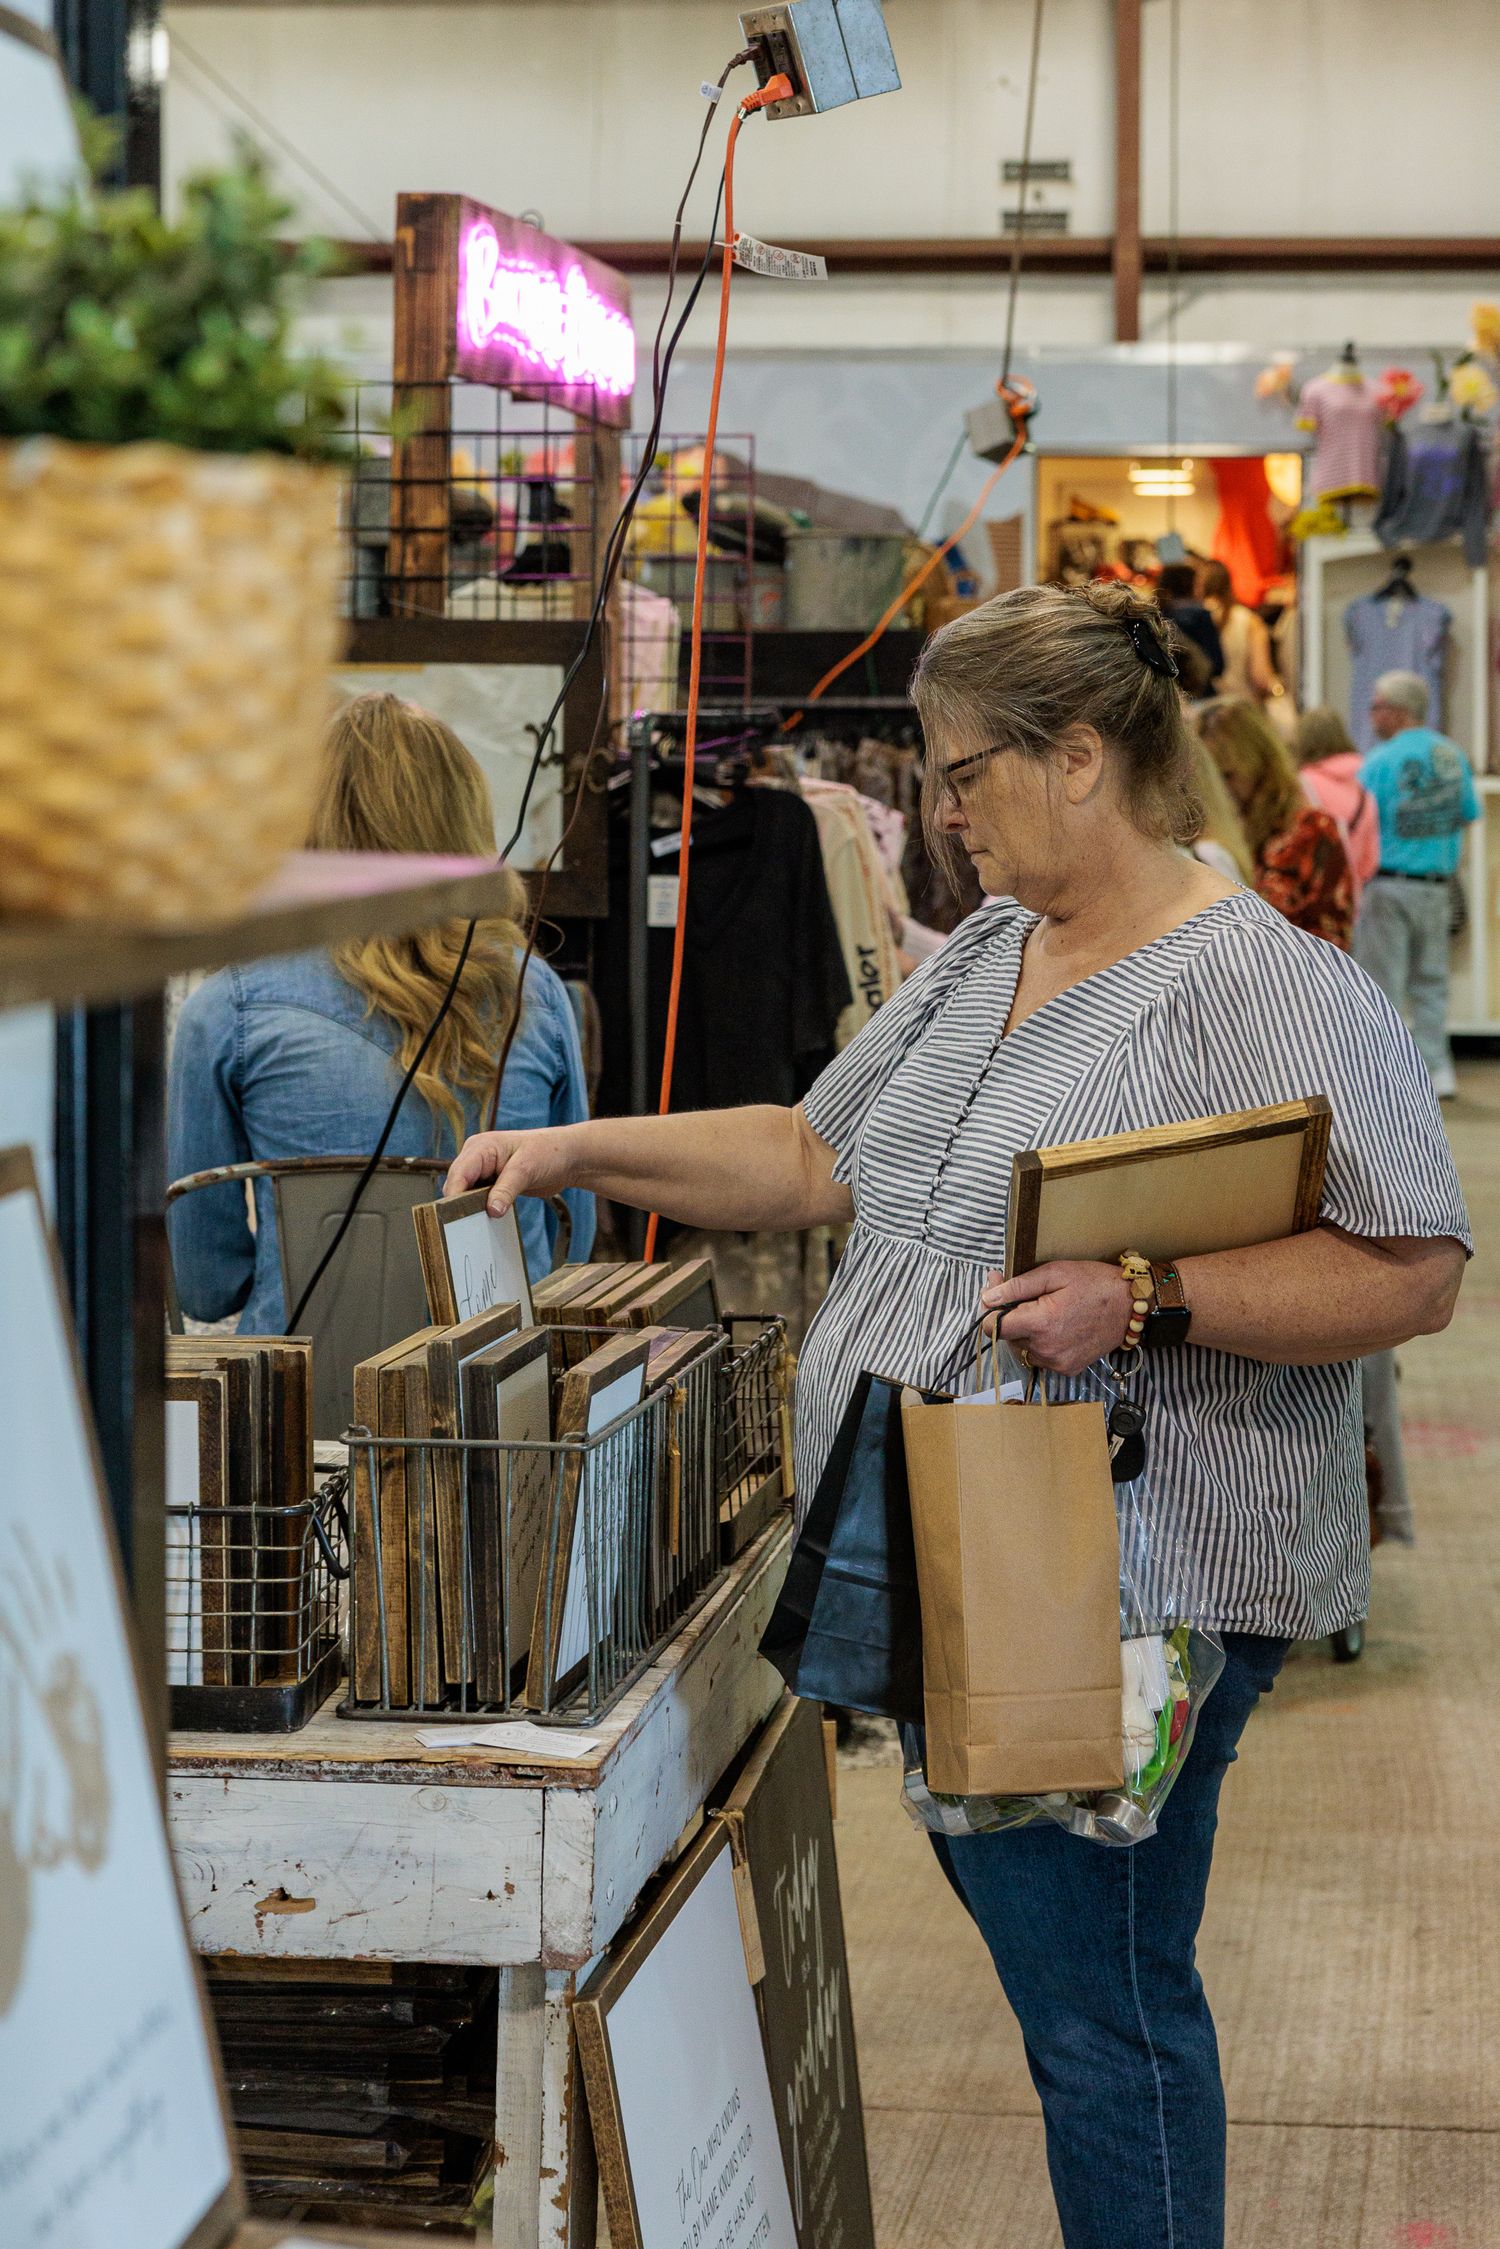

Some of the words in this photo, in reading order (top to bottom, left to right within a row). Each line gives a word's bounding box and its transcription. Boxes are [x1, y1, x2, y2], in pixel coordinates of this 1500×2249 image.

[706, 2123, 722, 2160] WHO
[720, 2087, 741, 2136] KNOWS
[692, 2216, 702, 2248] BY
[701, 2185, 720, 2231] NAME
[718, 2150, 739, 2200] KNOWS
[737, 2123, 753, 2163] YOUR
[732, 2198, 746, 2233] HAS
[744, 2175, 757, 2212] NOT
